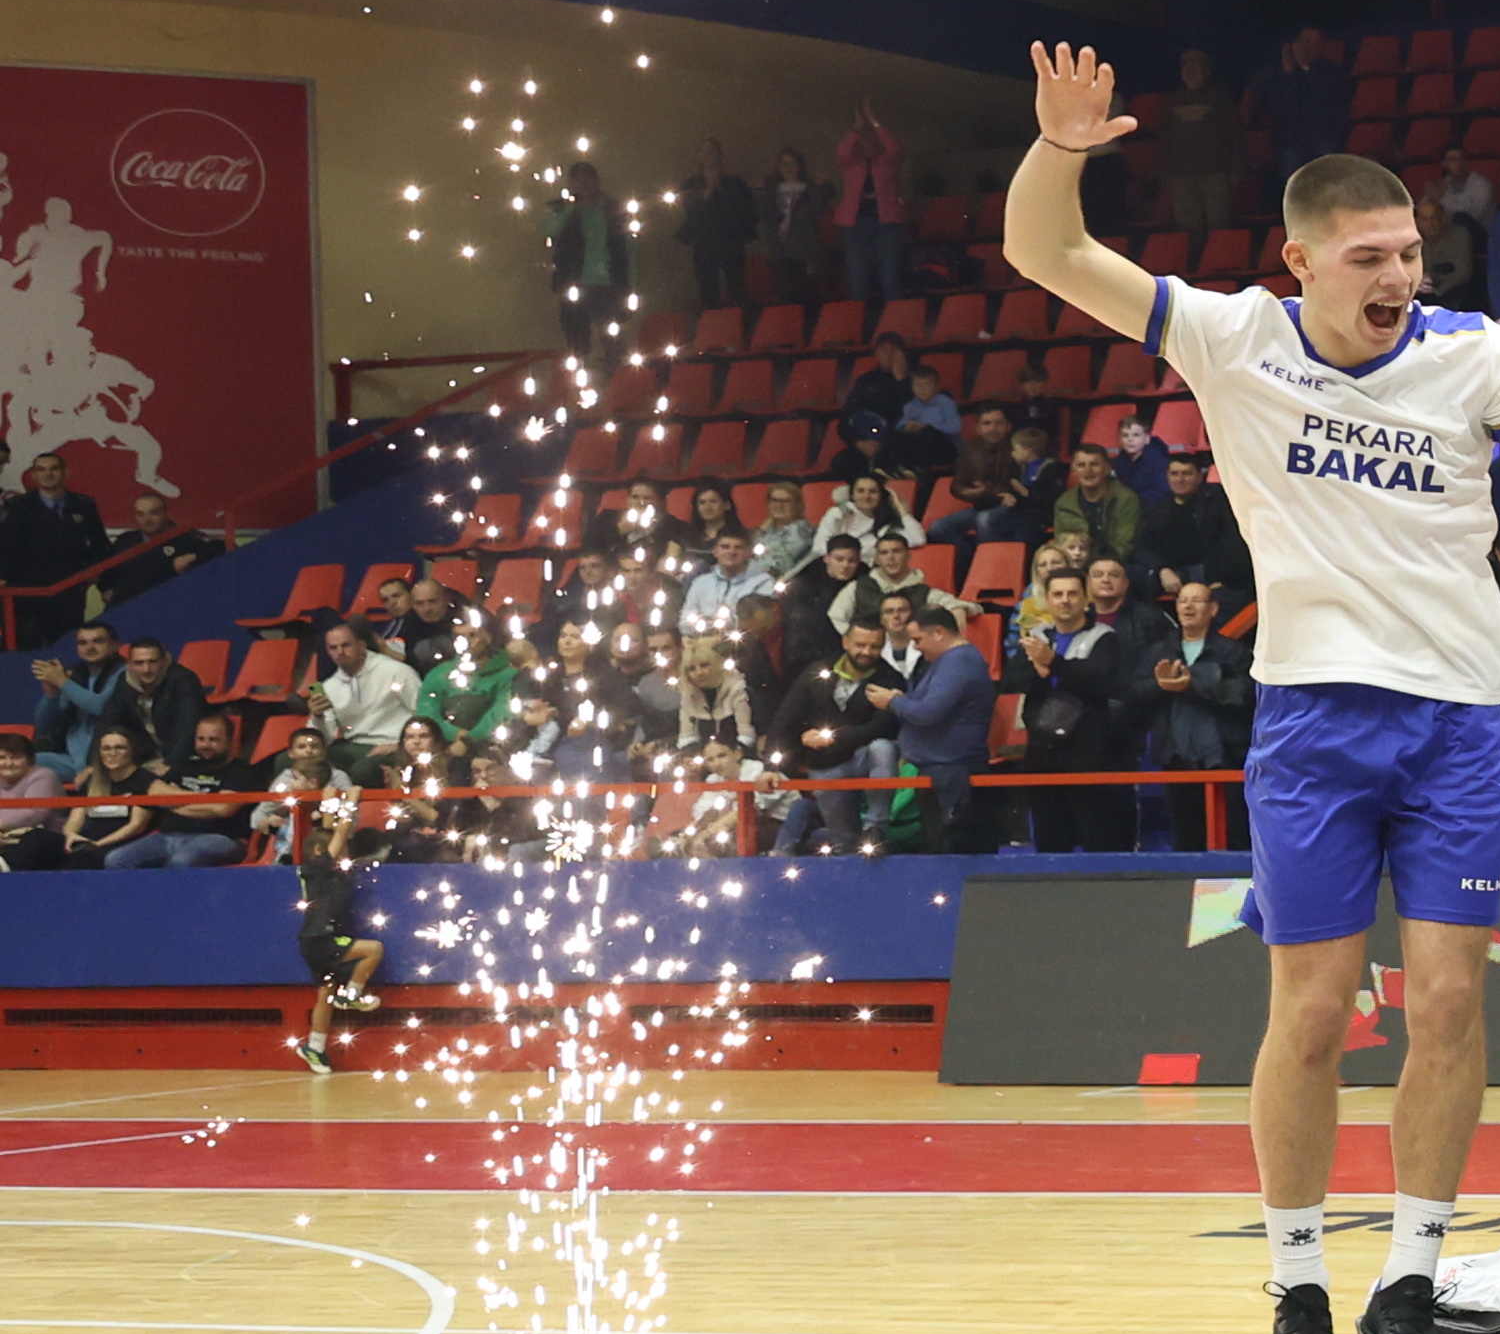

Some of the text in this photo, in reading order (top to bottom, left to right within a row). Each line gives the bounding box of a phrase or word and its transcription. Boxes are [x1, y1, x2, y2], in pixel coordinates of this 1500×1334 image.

[170, 247, 196, 260] THE
[1260, 360, 1325, 392] KELME
[1302, 413, 1435, 459] PEKARA
[1286, 442, 1446, 494] BAKAL
